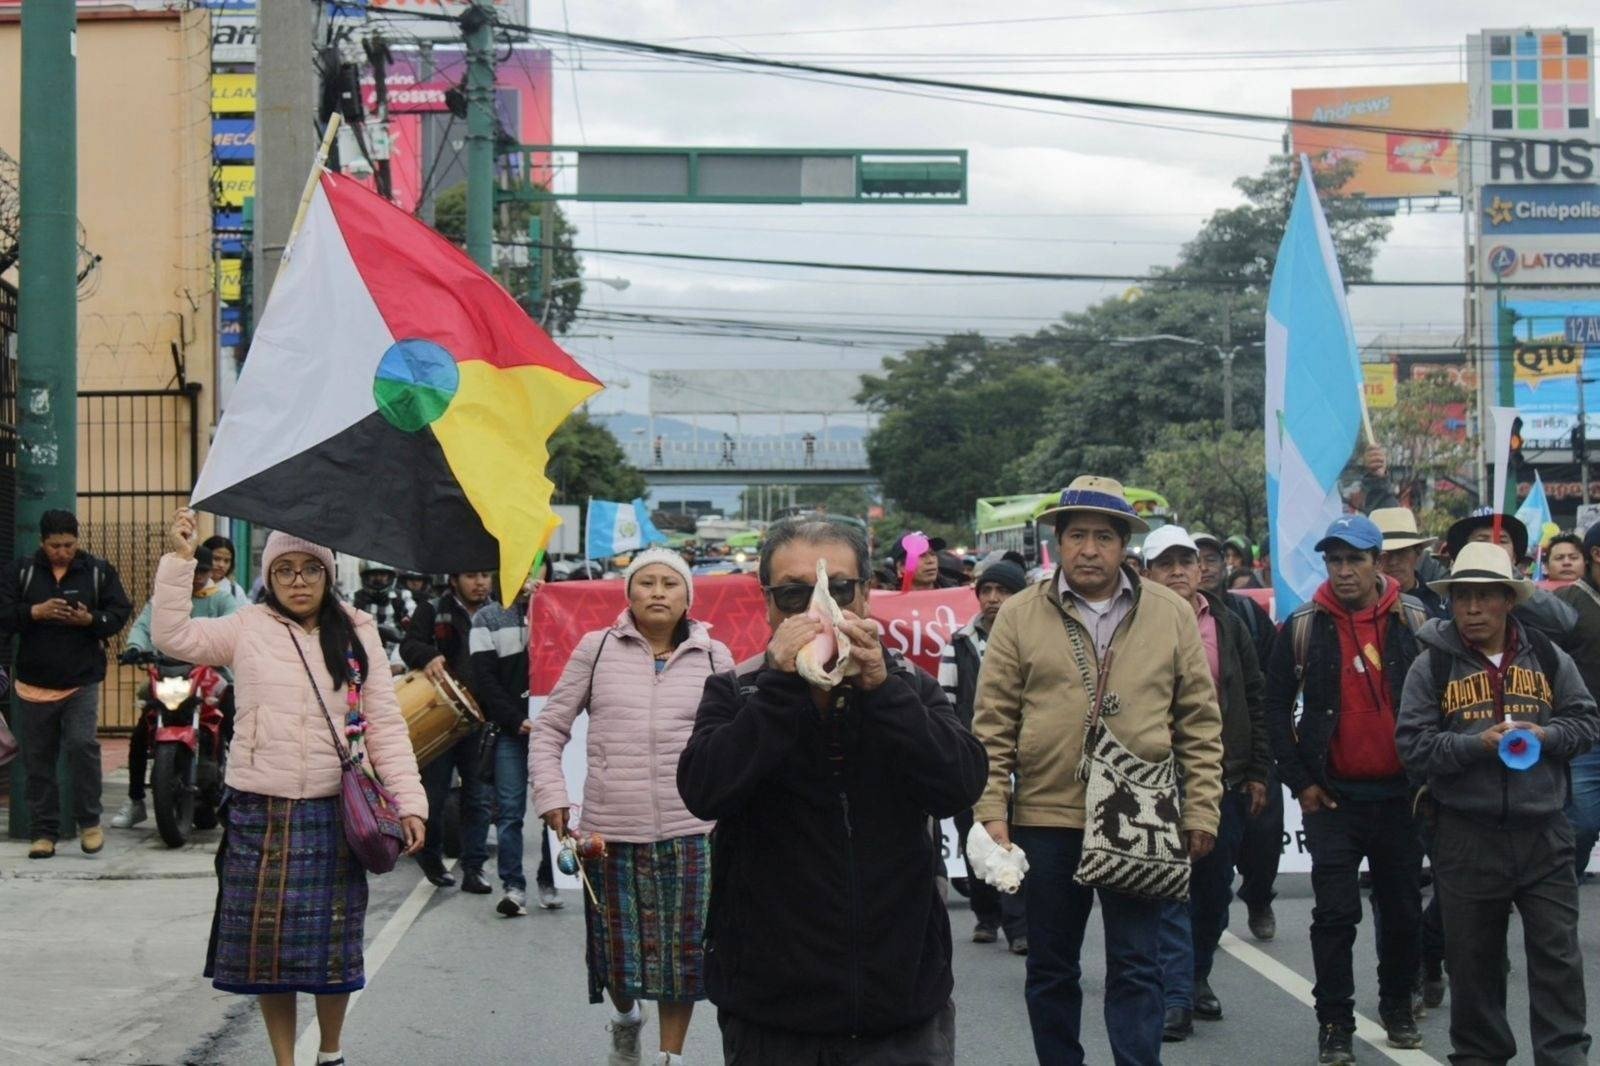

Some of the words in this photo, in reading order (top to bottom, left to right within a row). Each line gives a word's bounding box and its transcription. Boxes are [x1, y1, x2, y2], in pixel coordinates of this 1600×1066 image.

[1491, 138, 1594, 180] RUS
[1515, 200, 1600, 221] Cinépolis
[1570, 317, 1584, 342] 12
